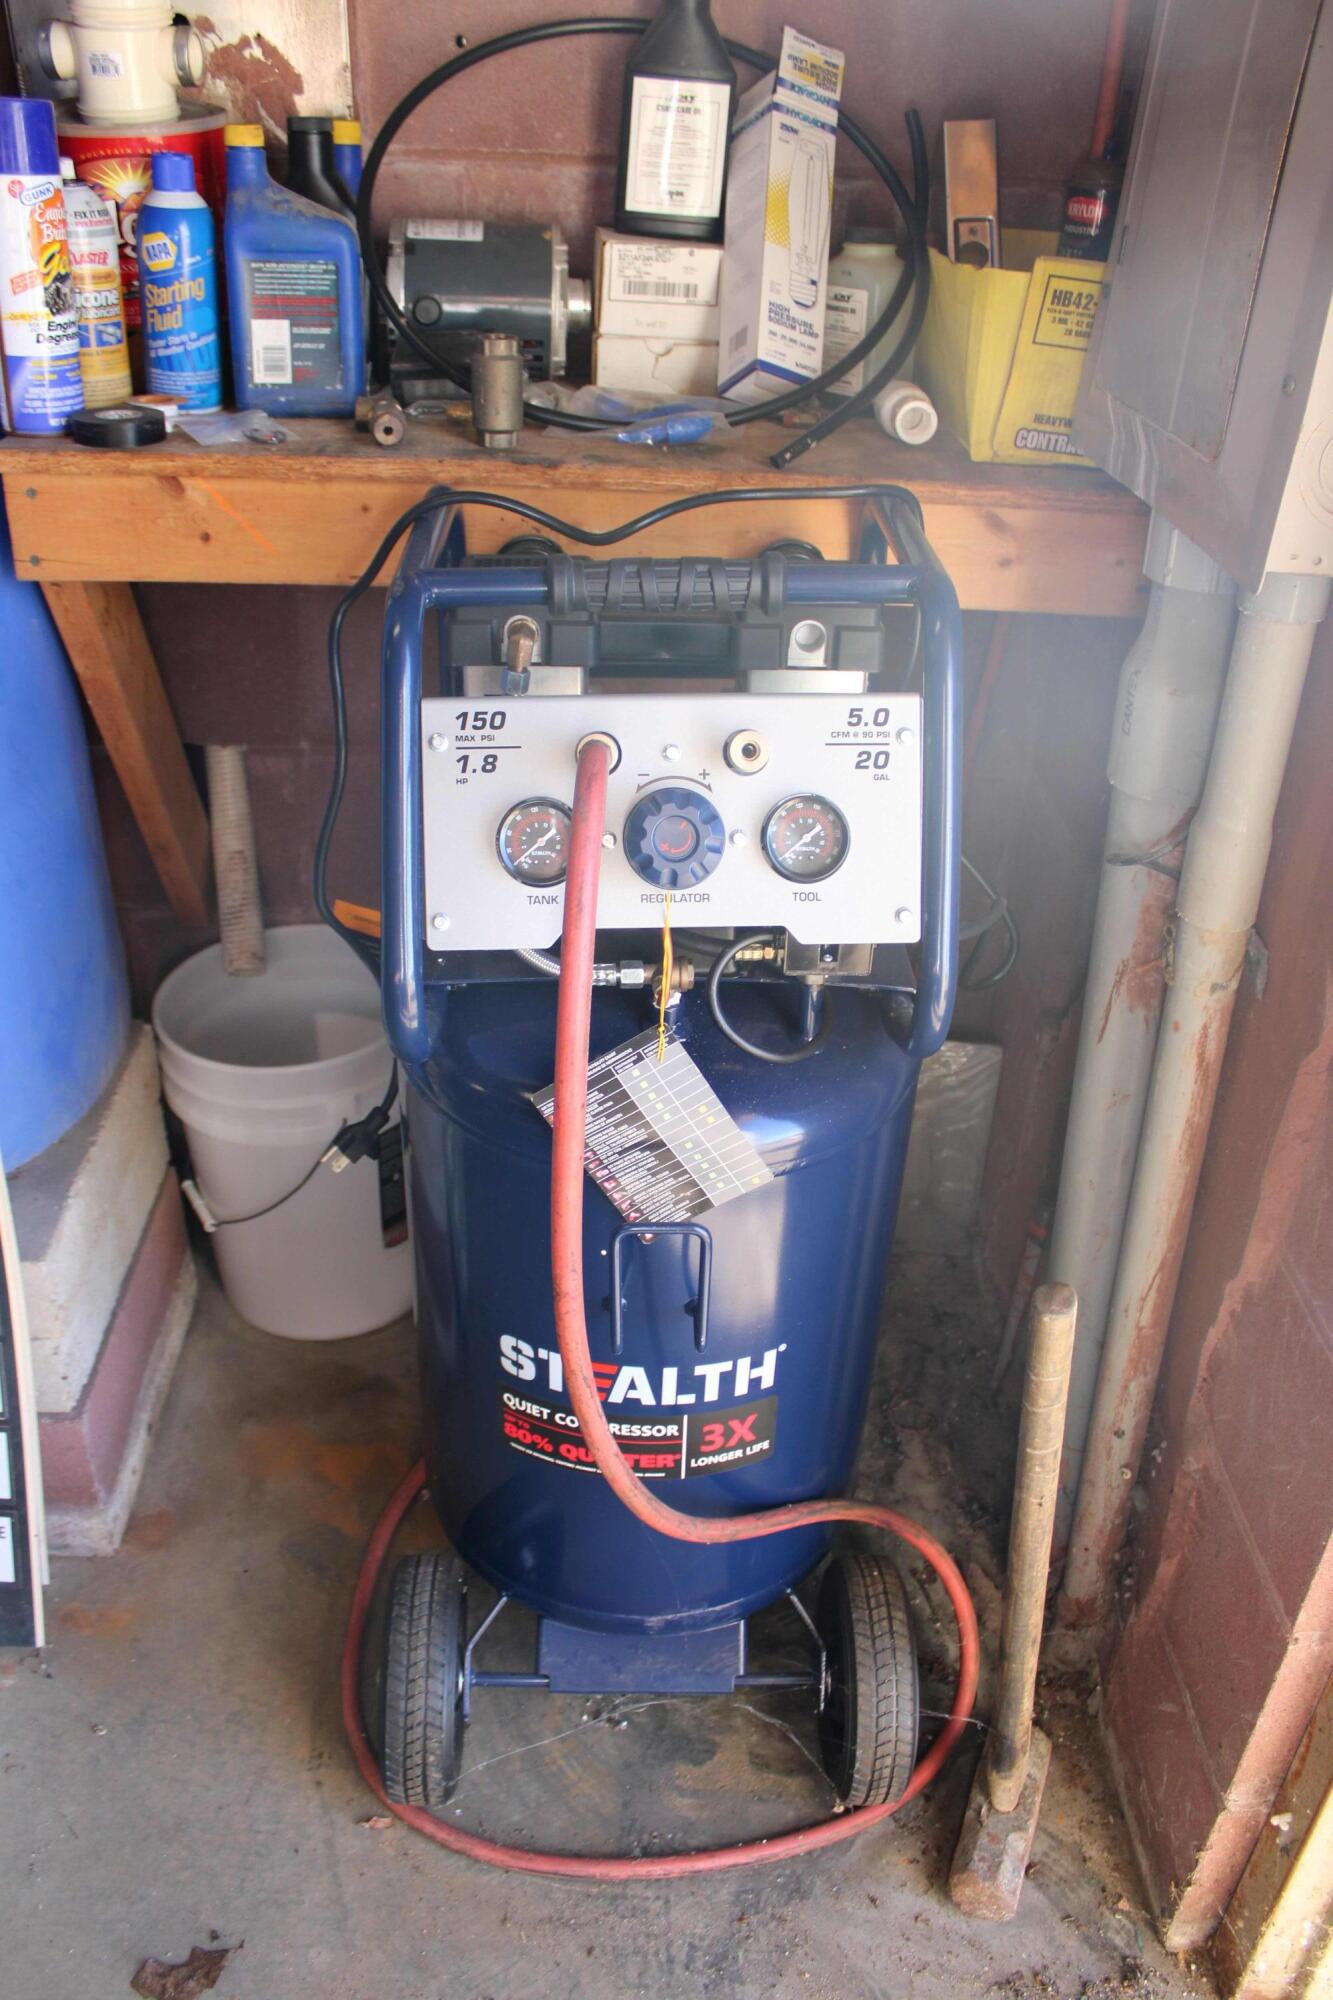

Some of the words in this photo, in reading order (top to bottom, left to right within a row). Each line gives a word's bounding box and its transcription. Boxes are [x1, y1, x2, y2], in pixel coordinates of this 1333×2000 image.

[1068, 202, 1103, 218] KRYLON
[145, 242, 173, 261] NAPA
[145, 277, 205, 306] Starting
[768, 300, 790, 314] HIGH
[146, 304, 182, 333] Fluid
[767, 314, 797, 331] SODIUM
[799, 326, 819, 339] LAMP
[768, 308, 814, 330] PRESSURE
[455, 711, 507, 731] 150
[847, 708, 890, 727] 5.0
[455, 754, 498, 774] 1.8
[854, 750, 890, 770] 20
[527, 895, 559, 905] TANK
[640, 893, 710, 903] REGULATOR
[793, 892, 822, 901] TOOL
[503, 1392, 551, 1419] QUIET
[554, 1413, 679, 1437] CORESSOR
[503, 1421, 554, 1452] 80%
[699, 1412, 758, 1453] 3X
[690, 1449, 743, 1468] LONGER
[746, 1440, 770, 1455] LIFE
